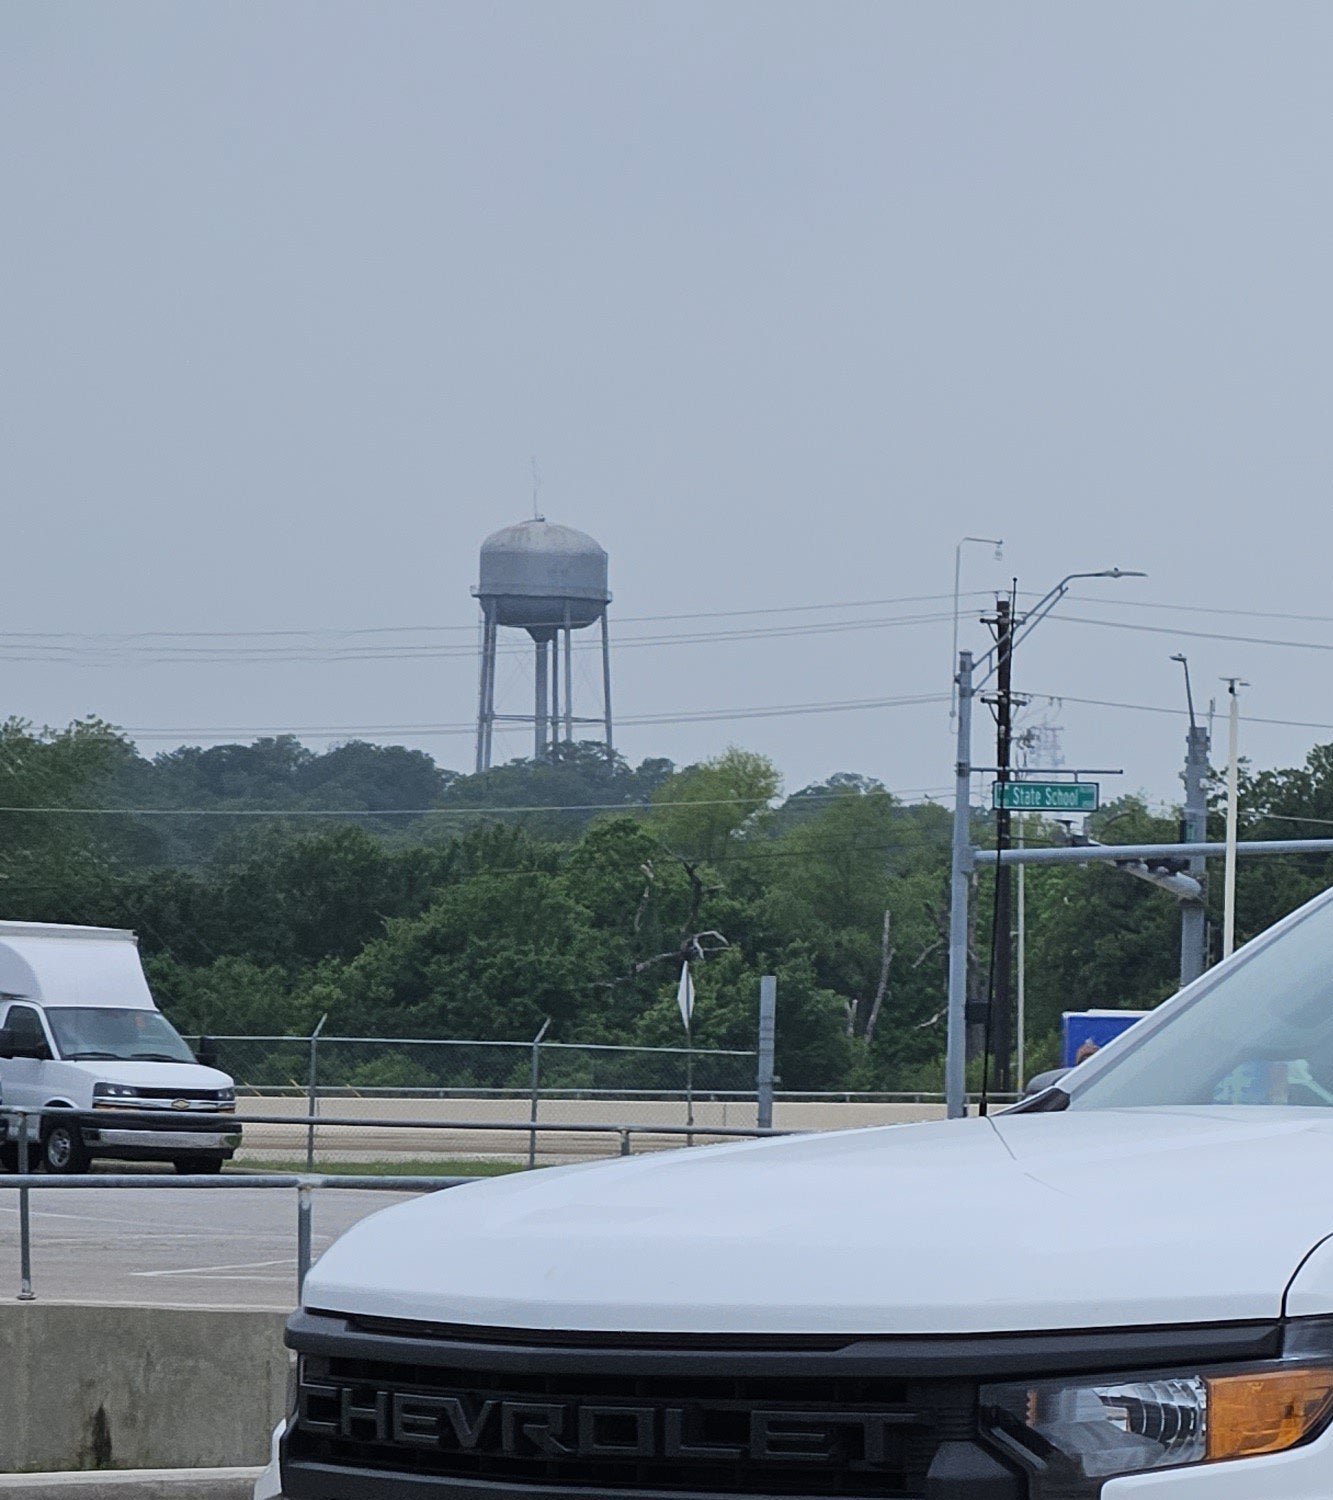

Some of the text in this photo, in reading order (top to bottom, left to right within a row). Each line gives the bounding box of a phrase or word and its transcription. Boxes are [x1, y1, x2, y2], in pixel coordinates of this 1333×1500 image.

[1013, 786, 1041, 806] State
[1045, 787, 1079, 807] School
[299, 1382, 920, 1465] CHEVROLET
